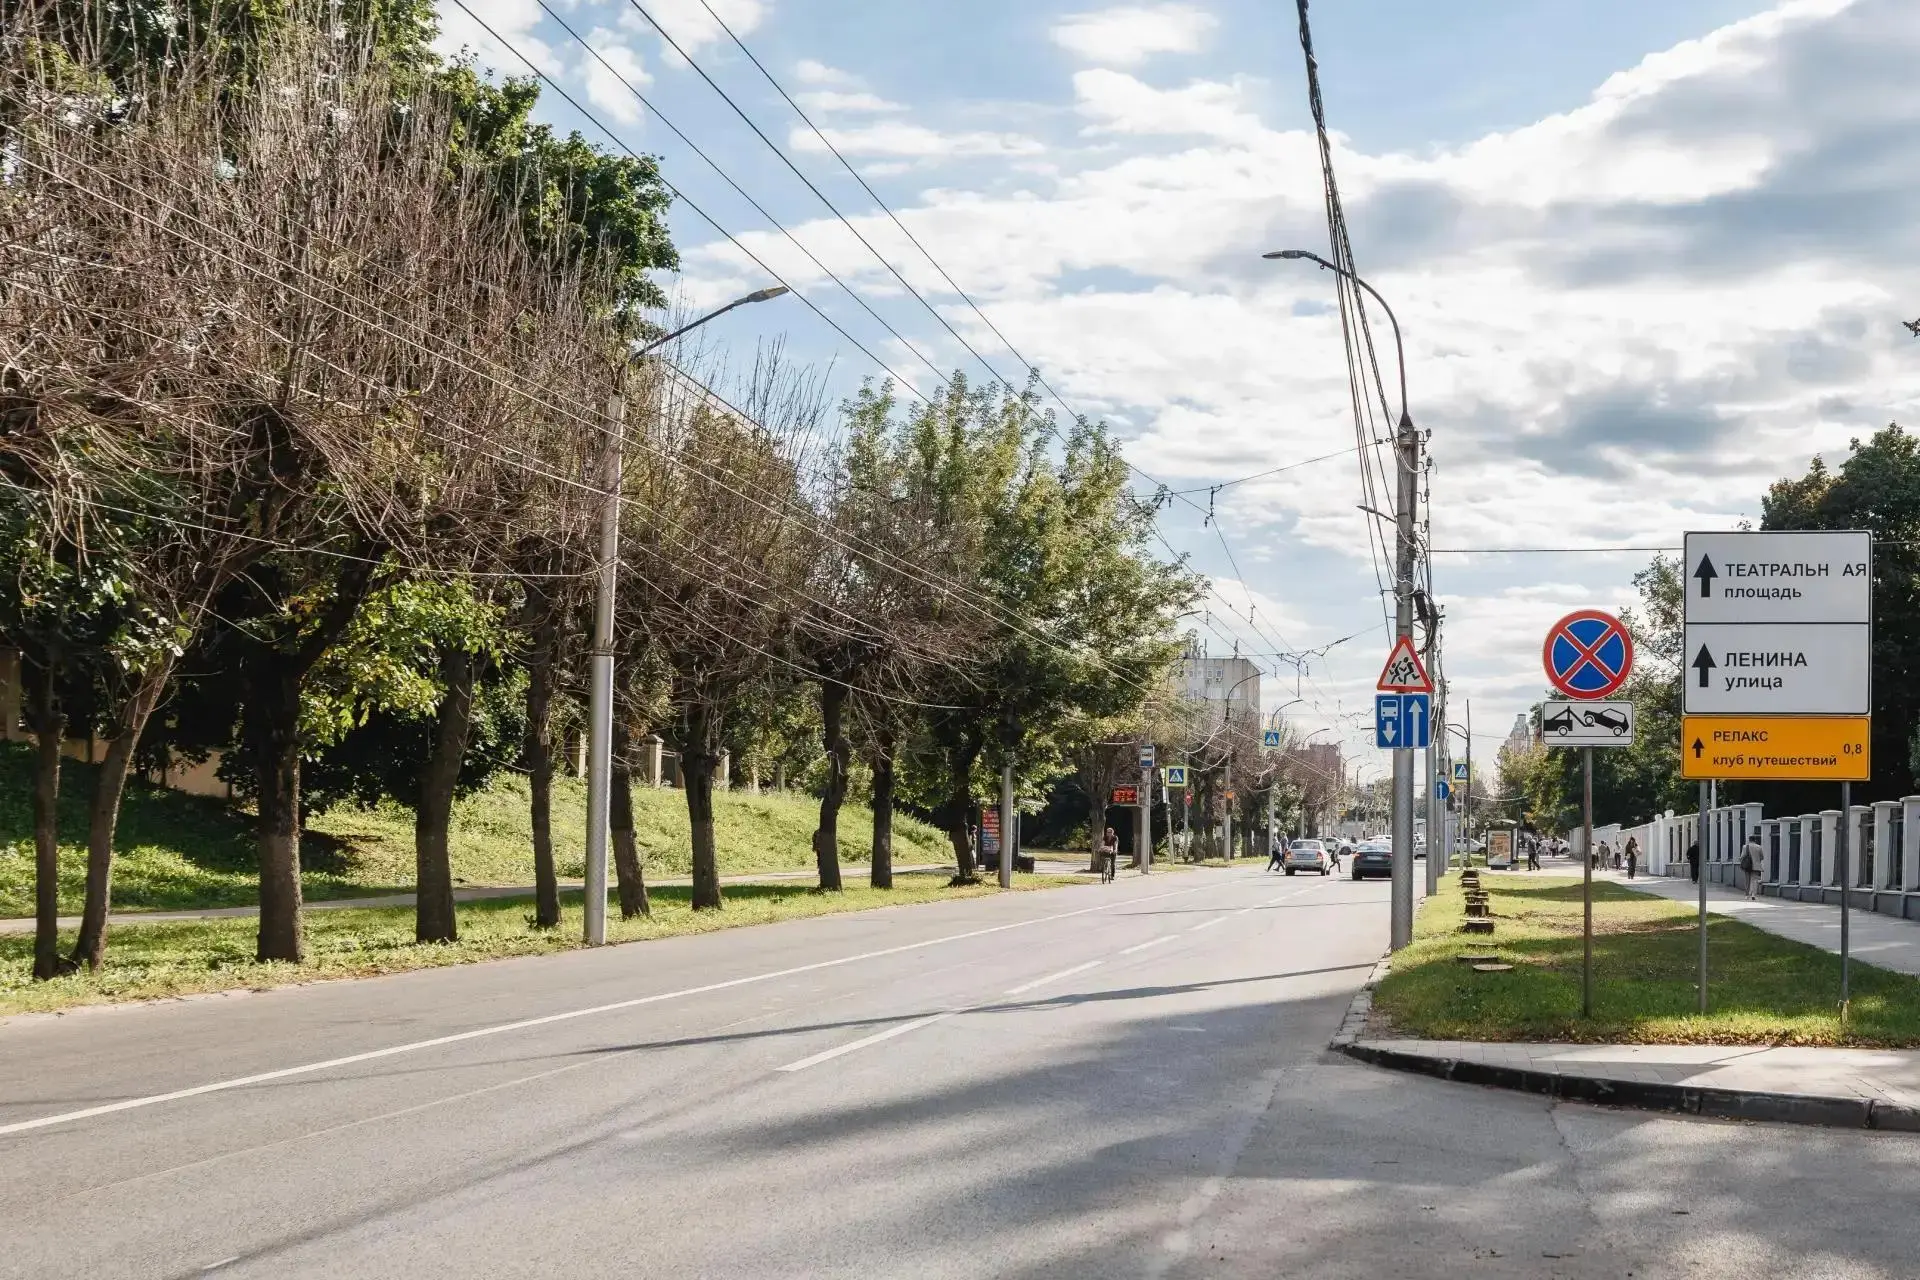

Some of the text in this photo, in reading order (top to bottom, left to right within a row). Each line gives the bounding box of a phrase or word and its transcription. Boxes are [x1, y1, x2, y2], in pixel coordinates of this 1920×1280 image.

[1724, 587, 1802, 600] площадь
[1724, 652, 1808, 667] ЛЕНИНА
[1724, 677, 1783, 691] улица
[1713, 730, 1768, 742] РЕЛАКС
[1842, 743, 1863, 756] 0,8
[1712, 754, 1837, 767] клуб путешествий
